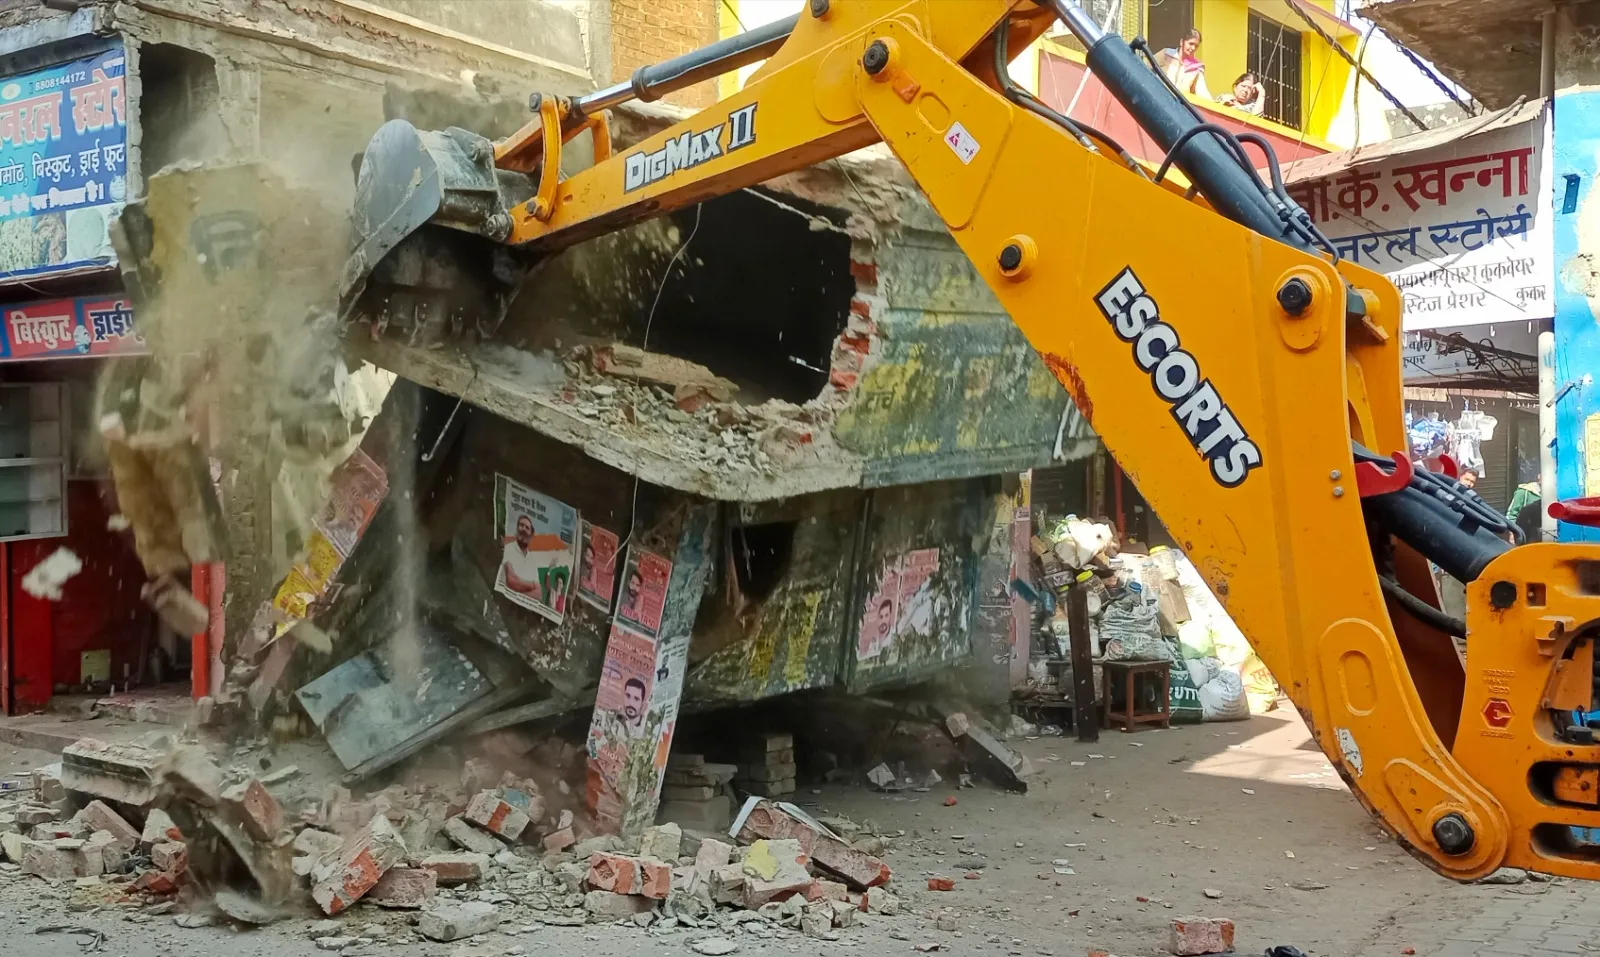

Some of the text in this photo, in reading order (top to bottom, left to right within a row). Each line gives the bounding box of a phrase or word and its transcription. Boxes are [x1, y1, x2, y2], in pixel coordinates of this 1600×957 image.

[0, 91, 63, 149] नरल
[1311, 227, 1421, 265] नरल
[10, 311, 72, 350] बिस्कुट
[1093, 264, 1264, 489] ESCORTS
